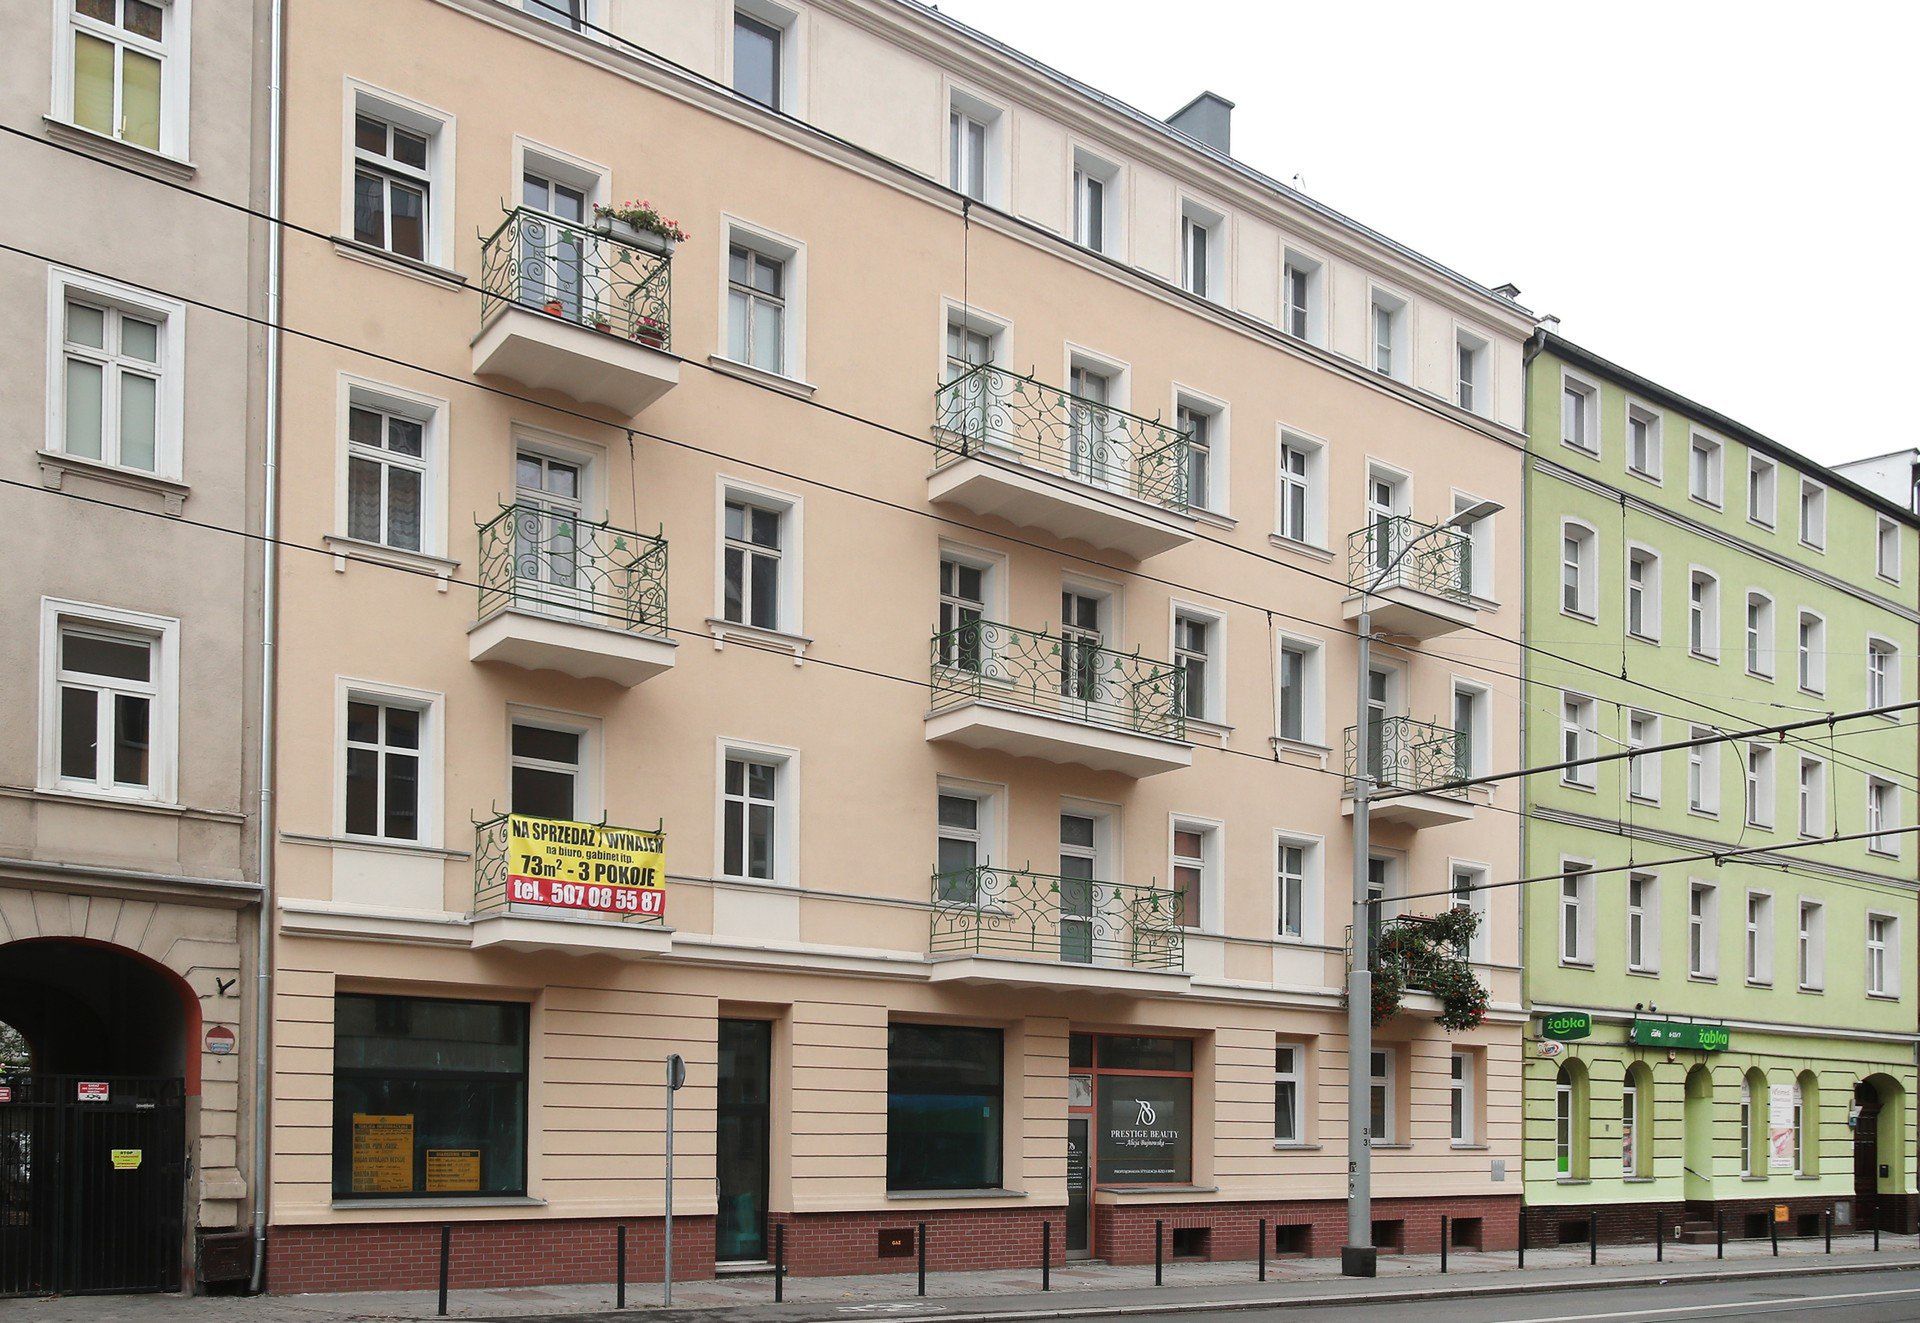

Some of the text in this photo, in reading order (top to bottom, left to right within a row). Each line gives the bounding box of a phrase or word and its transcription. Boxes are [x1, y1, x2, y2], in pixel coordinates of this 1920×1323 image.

[512, 820, 530, 838] NA
[532, 822, 596, 847] SPRZEDAŻ
[605, 832, 665, 854] WYNAJEM
[546, 846, 634, 864] na biuro, gabinet itp.
[578, 861, 590, 882] 3
[595, 863, 656, 887] POKOJE
[514, 879, 662, 912] tel. 507 08 55 87
[1548, 1018, 1586, 1030] żabka
[1699, 1029, 1727, 1046] żabka
[1110, 1129, 1179, 1139] PRESTIGE BEAUTY
